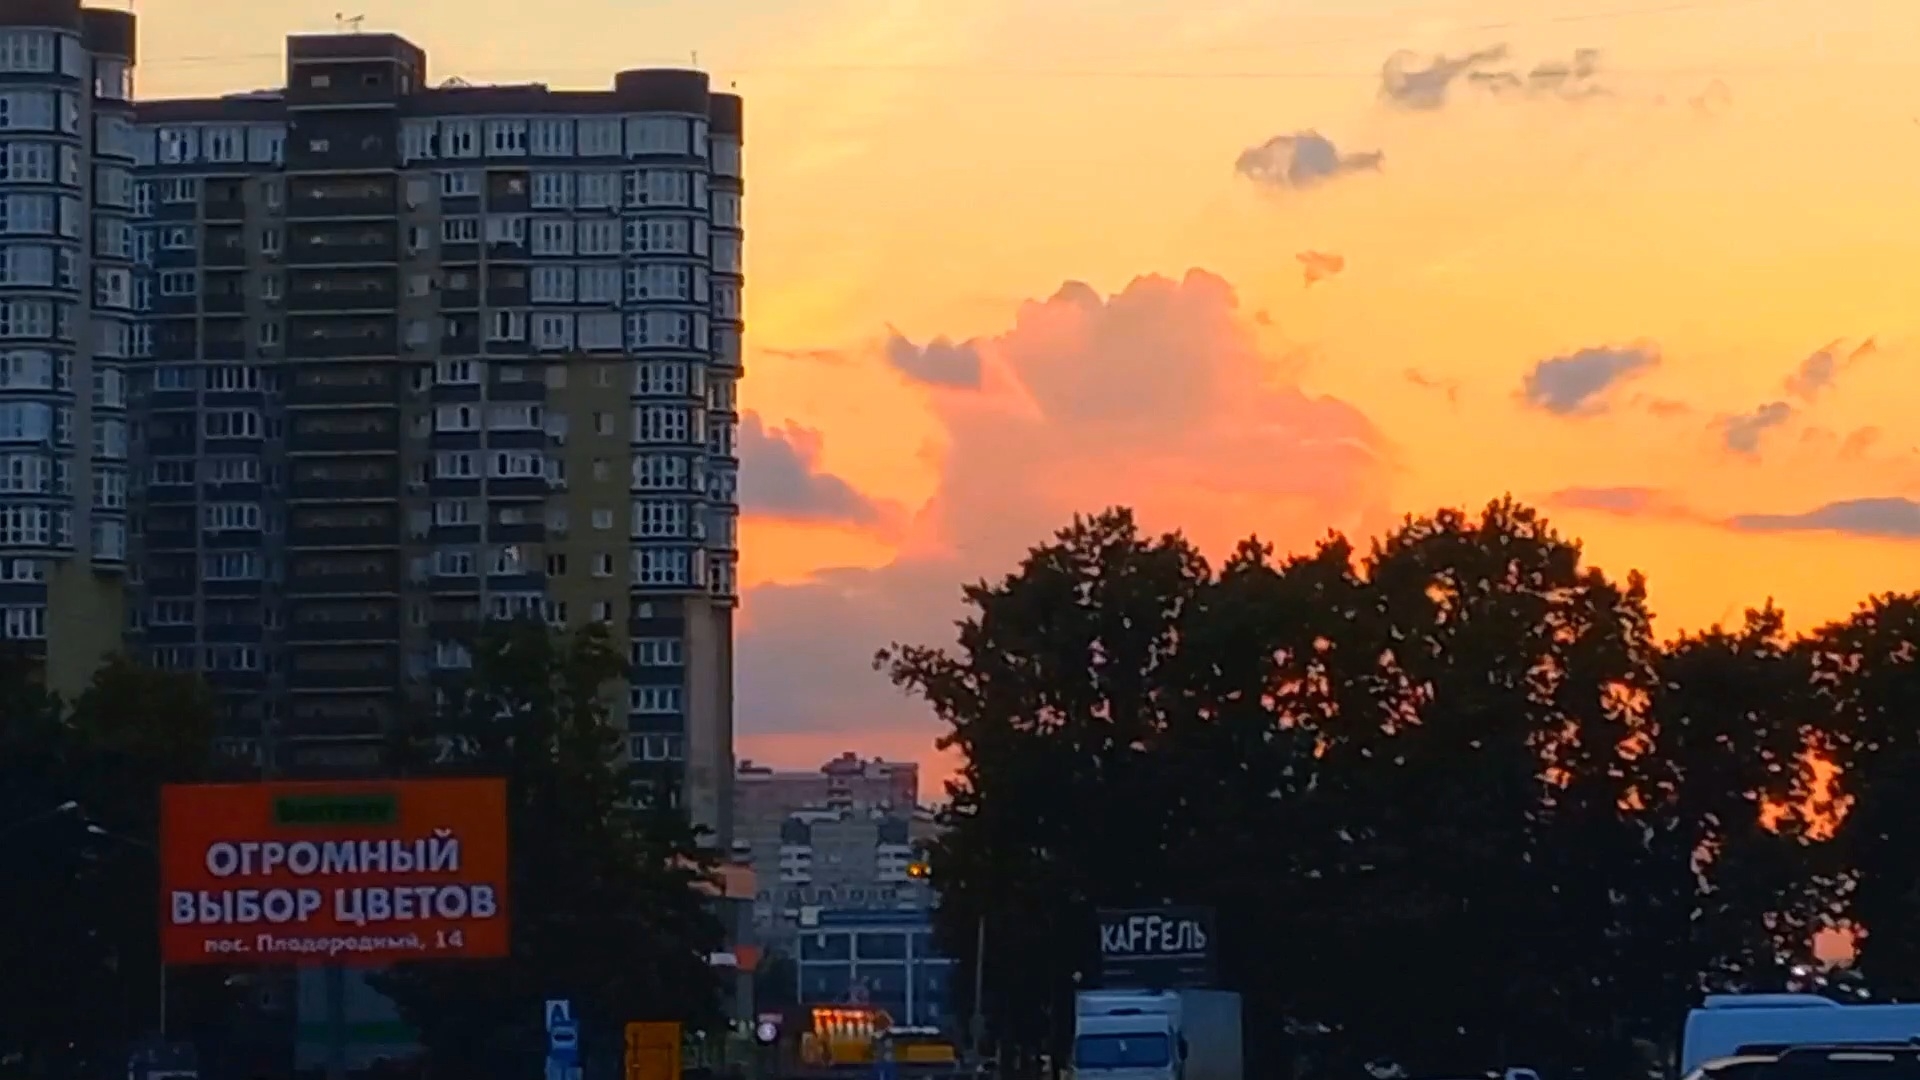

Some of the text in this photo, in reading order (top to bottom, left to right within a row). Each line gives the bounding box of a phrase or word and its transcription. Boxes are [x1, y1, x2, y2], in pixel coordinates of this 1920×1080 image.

[206, 828, 459, 876] ОГРОМНЫЙ
[171, 885, 497, 926] ВЫБОР ЦВЕТОВ
[203, 938, 250, 954] пос.
[435, 929, 464, 949] 14
